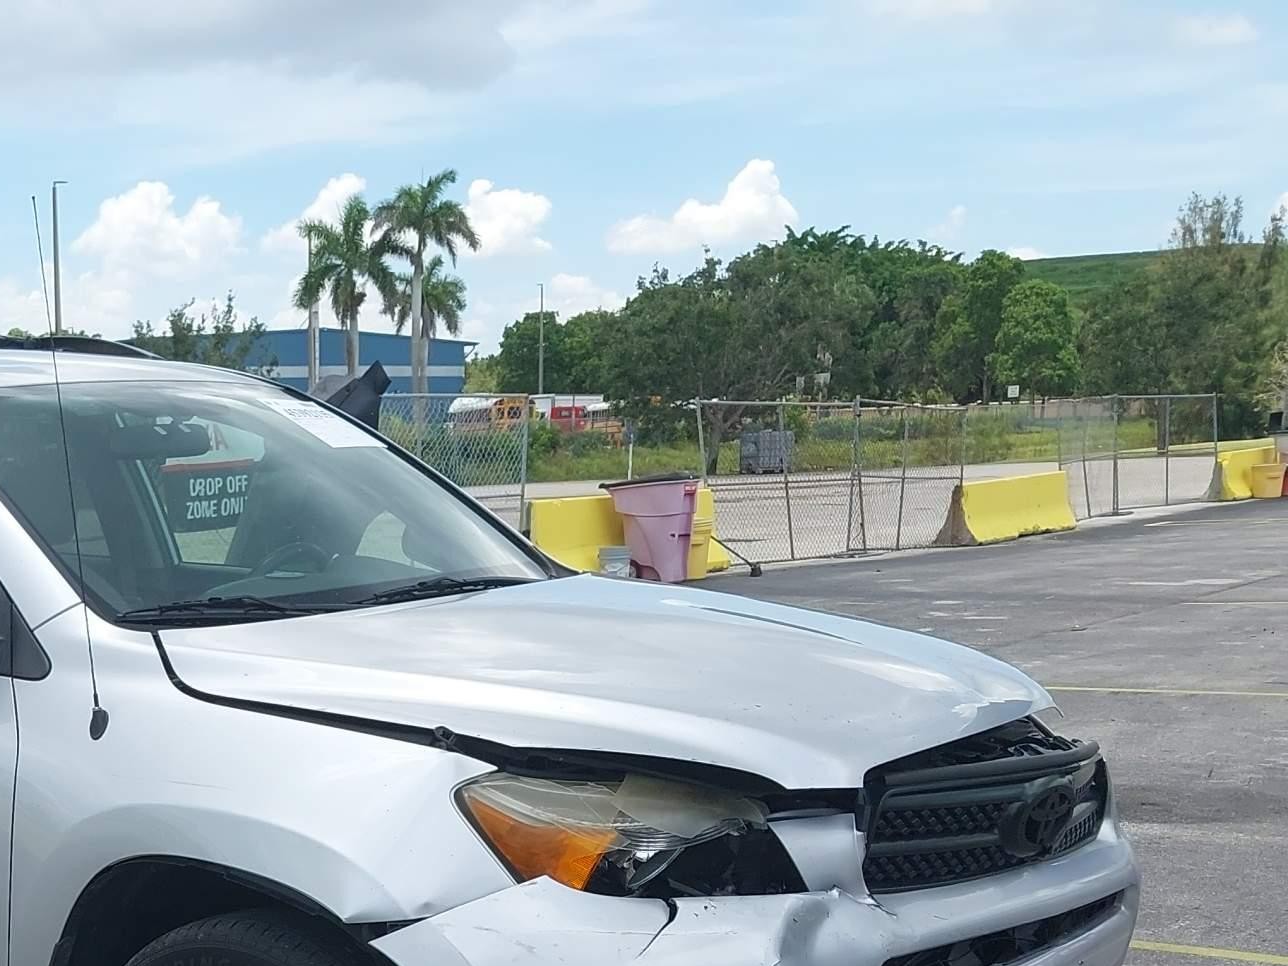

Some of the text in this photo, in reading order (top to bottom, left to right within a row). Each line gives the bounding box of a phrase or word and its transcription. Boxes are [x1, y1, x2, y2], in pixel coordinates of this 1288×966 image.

[189, 475, 248, 497] DROP OFF
[186, 496, 249, 519] ZONE ONL
